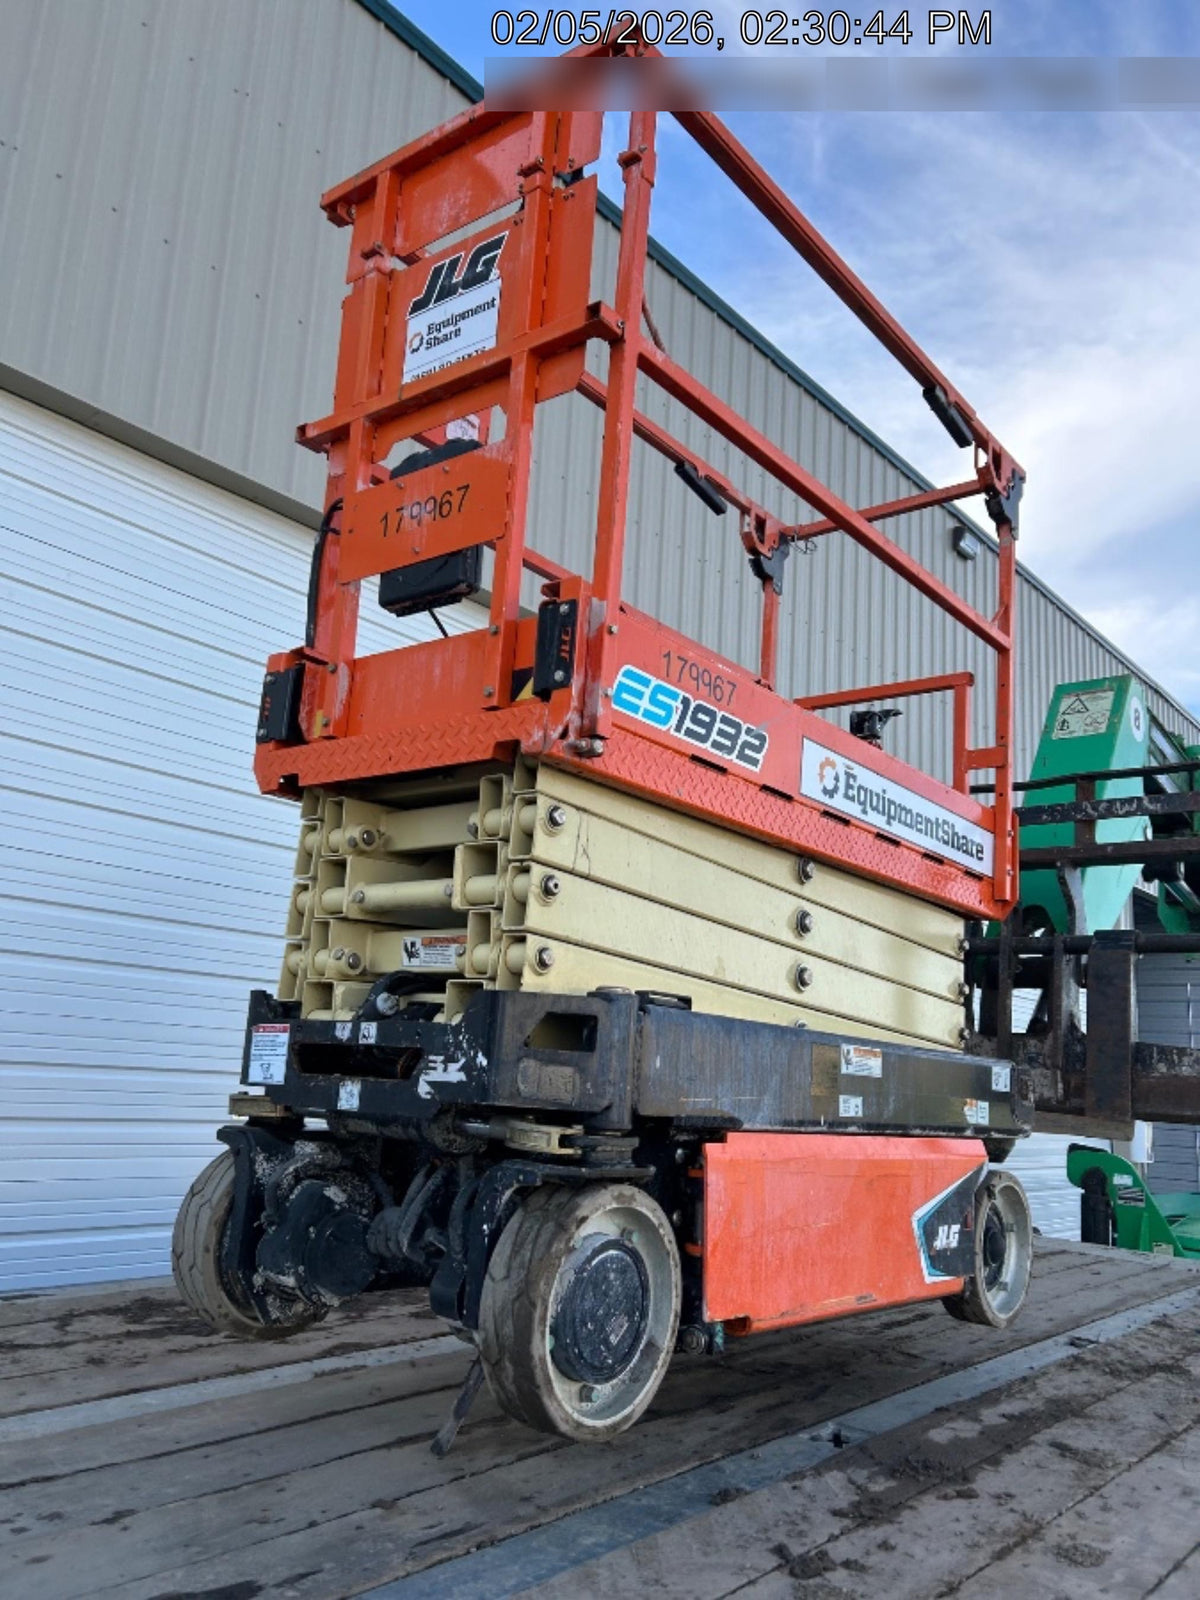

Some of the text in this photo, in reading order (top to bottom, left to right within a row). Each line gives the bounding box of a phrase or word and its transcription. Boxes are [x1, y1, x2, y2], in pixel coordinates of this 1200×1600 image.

[407, 230, 509, 318] JLG
[425, 327, 461, 351] Share
[427, 297, 497, 336] Equipment
[380, 483, 470, 537] 179967
[663, 650, 737, 706] 179967
[612, 665, 768, 773] ES1932
[842, 769, 984, 861] EquipmentShare
[933, 1224, 961, 1250] JLG
